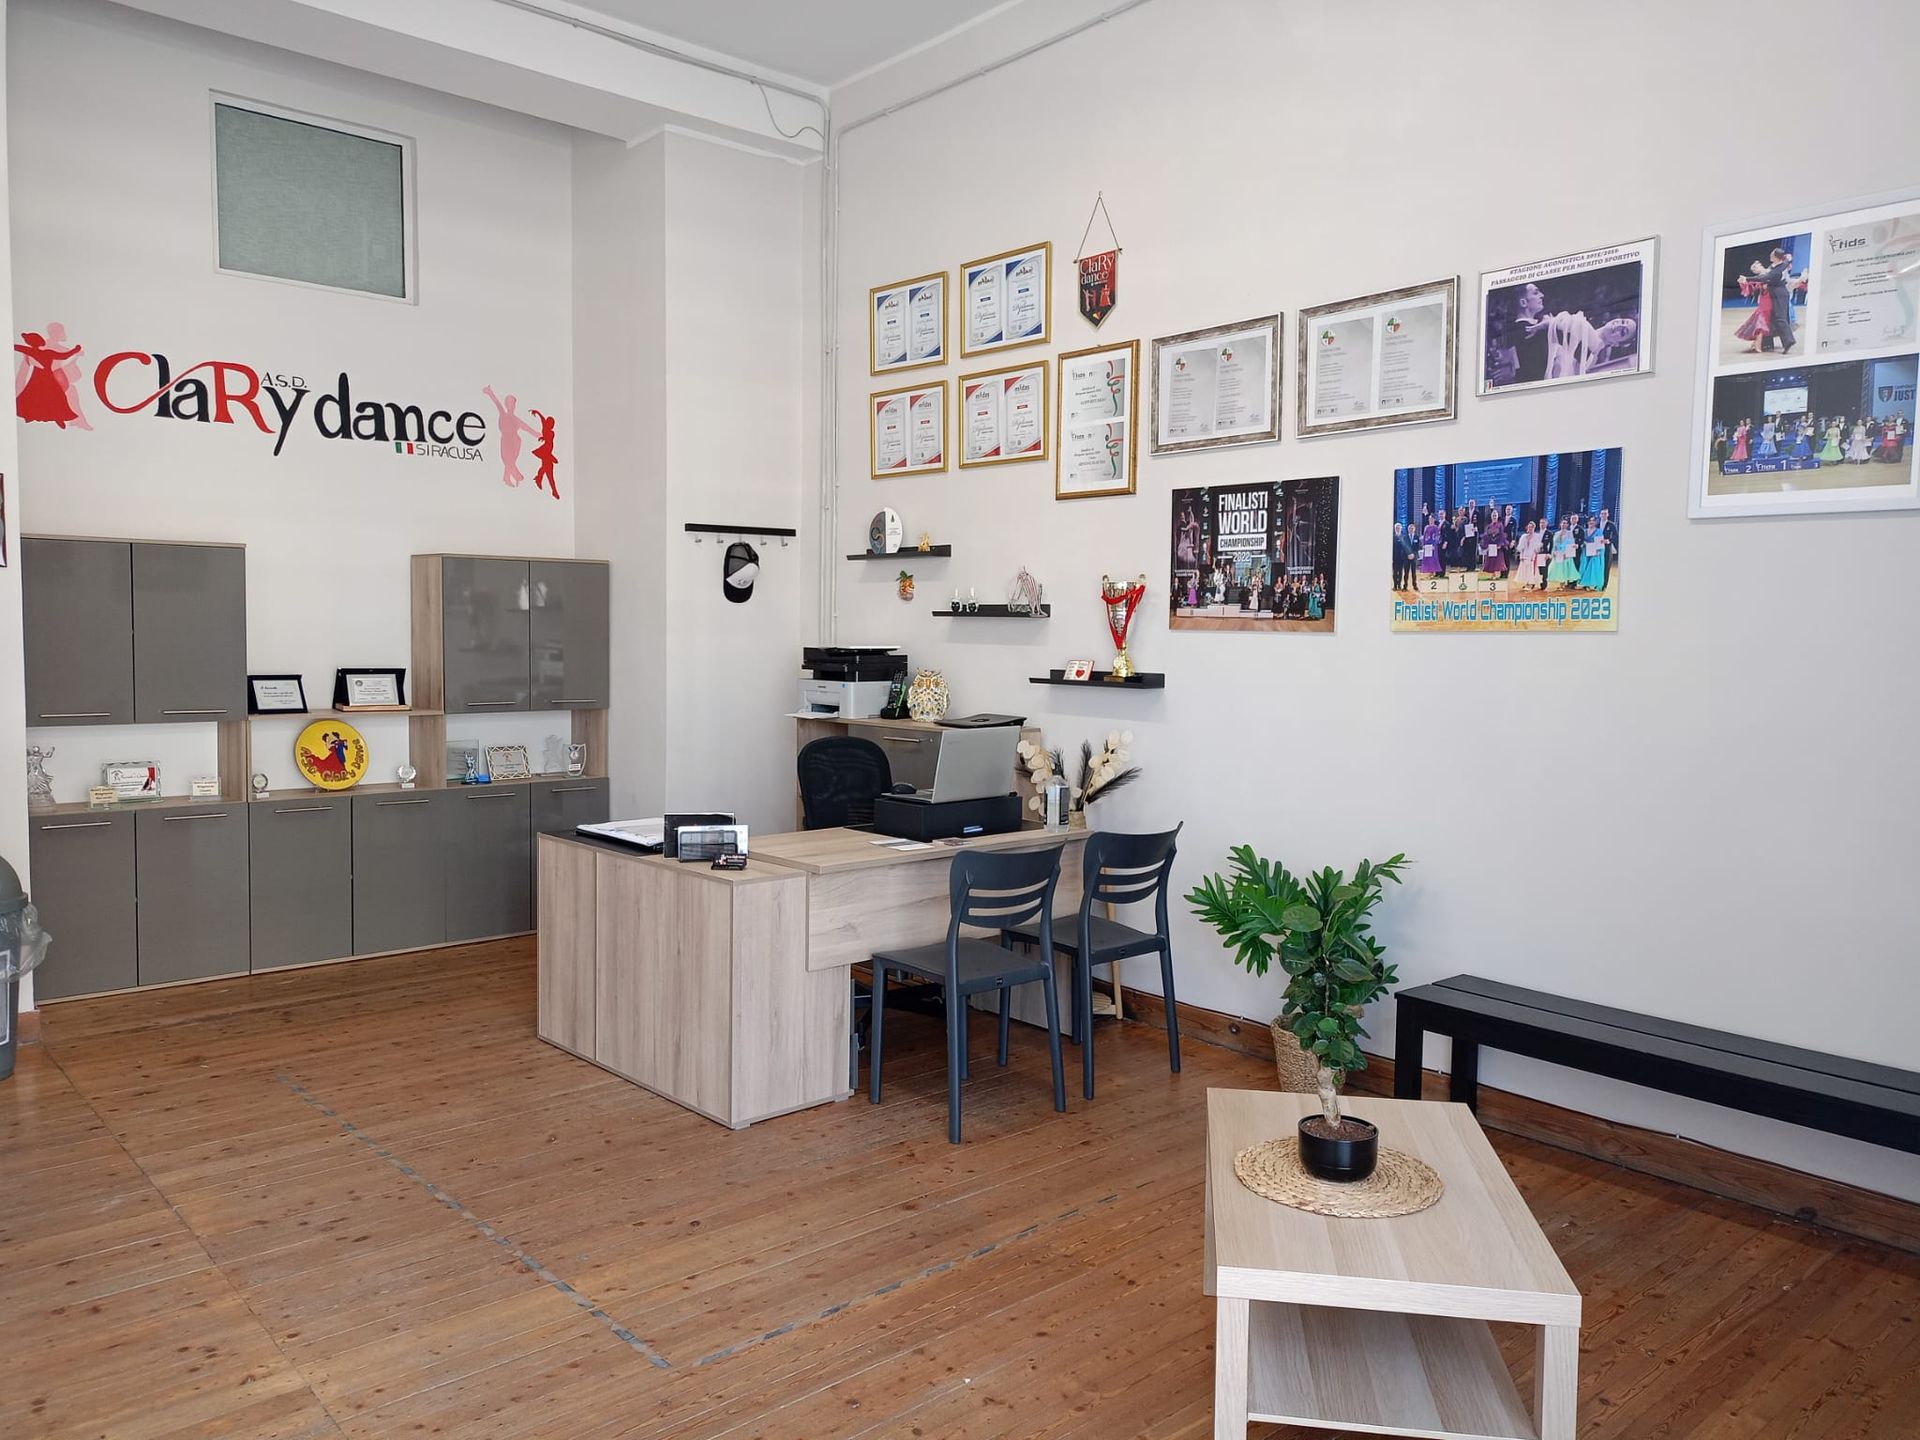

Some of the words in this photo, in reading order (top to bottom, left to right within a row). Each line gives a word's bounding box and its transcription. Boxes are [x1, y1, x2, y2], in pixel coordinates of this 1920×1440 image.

[1491, 273, 1527, 286] PASSAGGIO
[1528, 271, 1536, 279] DI
[1536, 266, 1561, 277] CLASSE
[1562, 263, 1576, 272] PER
[1575, 257, 1604, 270] MERITO
[1604, 251, 1640, 264] SPORTIVO
[1510, 264, 1542, 275] STAGIONE
[1544, 255, 1585, 269] AGONISTICA
[261, 372, 307, 389] A.S.D.
[314, 372, 487, 446] dance
[415, 443, 484, 462] SIRACUSA
[1218, 490, 1268, 511] FINALISTI
[1218, 510, 1268, 535] WORLD
[1220, 536, 1265, 549] CHAMPIONSHIP
[1232, 551, 1251, 562] 2022
[1431, 581, 1438, 590] 2
[1459, 574, 1466, 583] 1
[1489, 582, 1496, 591] 3
[1394, 601, 1439, 621] Finalisti
[1441, 600, 1478, 621] World
[1480, 600, 1567, 626] Championship
[1570, 597, 1611, 620] 2023
